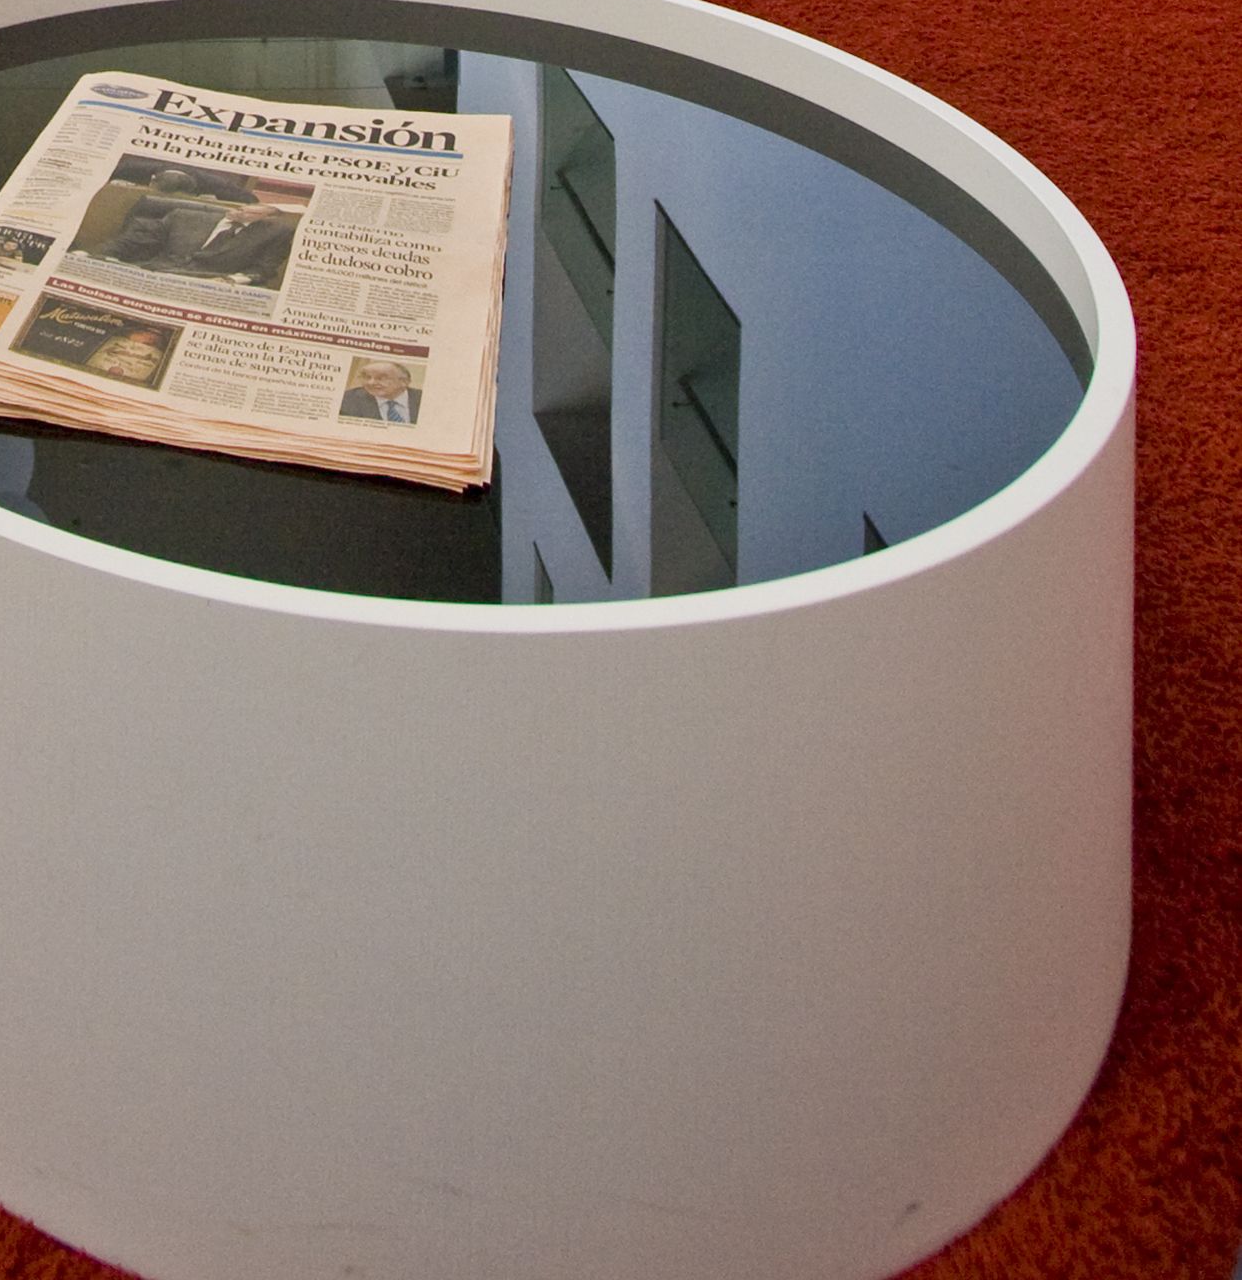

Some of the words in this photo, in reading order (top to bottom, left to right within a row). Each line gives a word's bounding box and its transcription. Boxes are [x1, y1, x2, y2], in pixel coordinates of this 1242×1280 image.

[148, 88, 458, 151] Expansión
[131, 137, 159, 150] en
[162, 140, 182, 154] la
[184, 148, 269, 171] política
[274, 161, 303, 175] de
[307, 168, 436, 191] renovables
[138, 124, 224, 150] Marcha
[227, 143, 283, 158] atrás
[287, 150, 317, 163] de
[322, 154, 391, 172] PSOE
[394, 165, 409, 176] y
[414, 165, 459, 178] CiU
[301, 236, 369, 256] ingresos
[371, 247, 431, 265] deudas
[304, 226, 391, 246] contabiliza
[395, 240, 442, 253] como
[298, 249, 318, 263] de
[321, 252, 381, 272] dudoso
[384, 264, 434, 281] cobro
[51, 279, 75, 290] Las
[77, 285, 120, 303] bolsas
[122, 299, 184, 318] europeas
[186, 311, 203, 320] se
[205, 313, 249, 329] sitúan
[251, 324, 269, 333] en
[271, 326, 334, 343] máximos
[336, 337, 391, 352] anuales
[321, 322, 381, 339] millones
[415, 327, 433, 336] de
[186, 340, 203, 350] se
[232, 348, 259, 359] con
[262, 352, 275, 364] la
[278, 354, 307, 369] Fed
[308, 361, 342, 376] para
[191, 330, 207, 340] El
[210, 333, 255, 348] Banco
[256, 341, 275, 351] de
[278, 345, 331, 362] España
[183, 349, 227, 365] temas
[229, 357, 248, 368] de
[250, 362, 335, 383] supervisión
